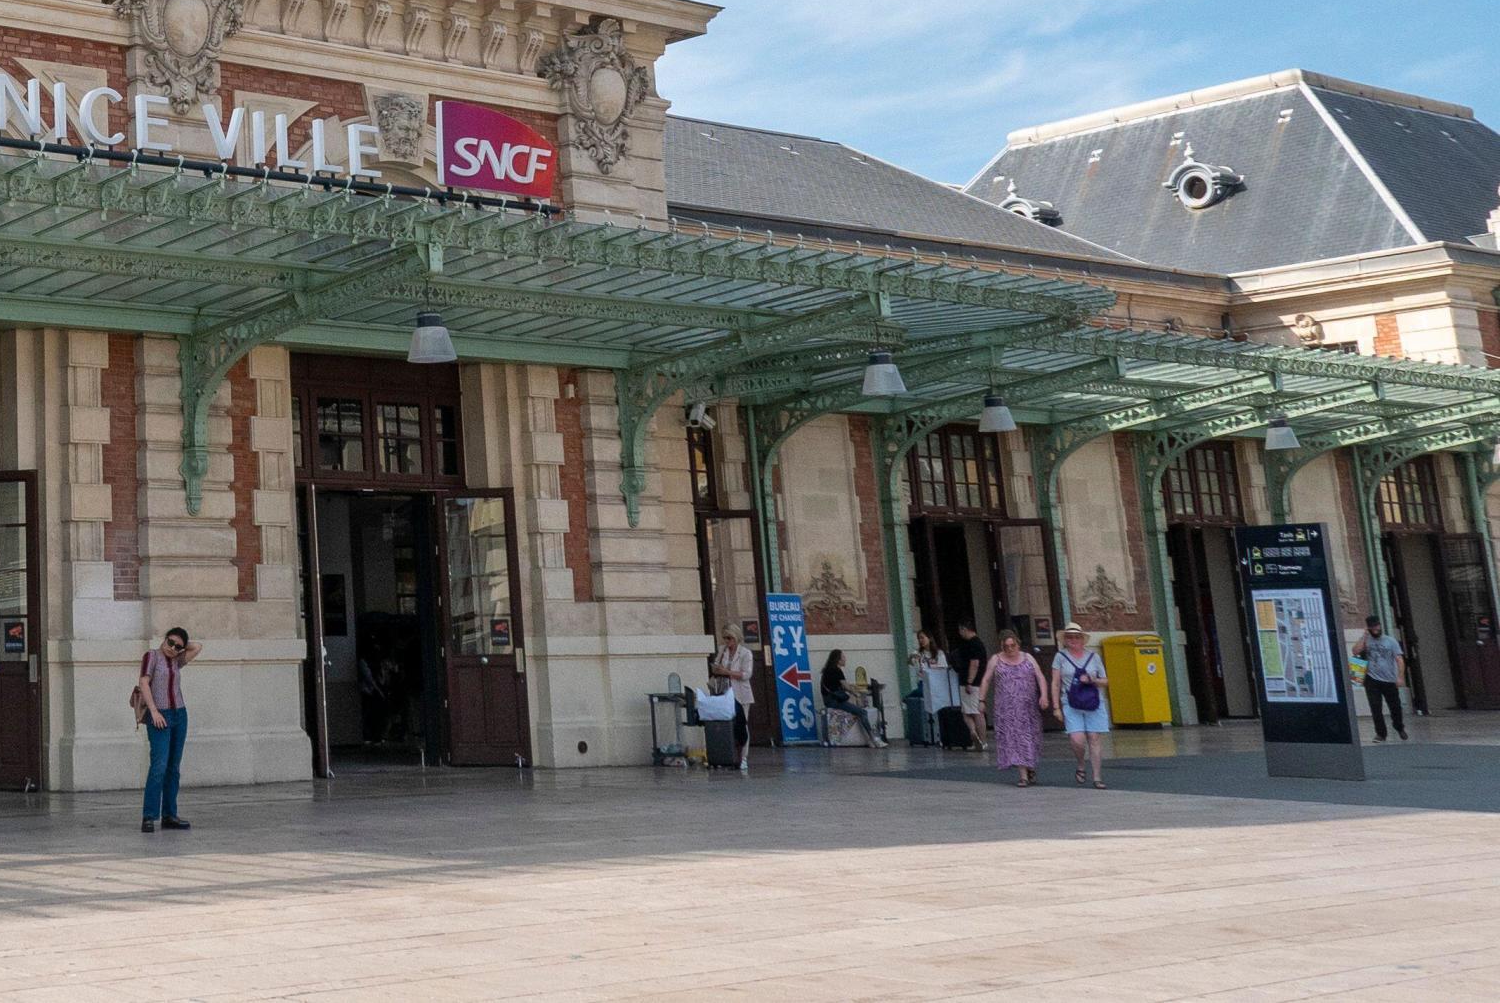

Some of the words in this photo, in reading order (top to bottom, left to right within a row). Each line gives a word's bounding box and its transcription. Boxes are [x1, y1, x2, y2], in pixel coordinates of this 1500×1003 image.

[202, 104, 382, 178] VILLE
[449, 137, 552, 185] SNCF
[769, 601, 800, 612] BUREAU
[771, 613, 778, 622] DE
[779, 613, 802, 622] CHANGE
